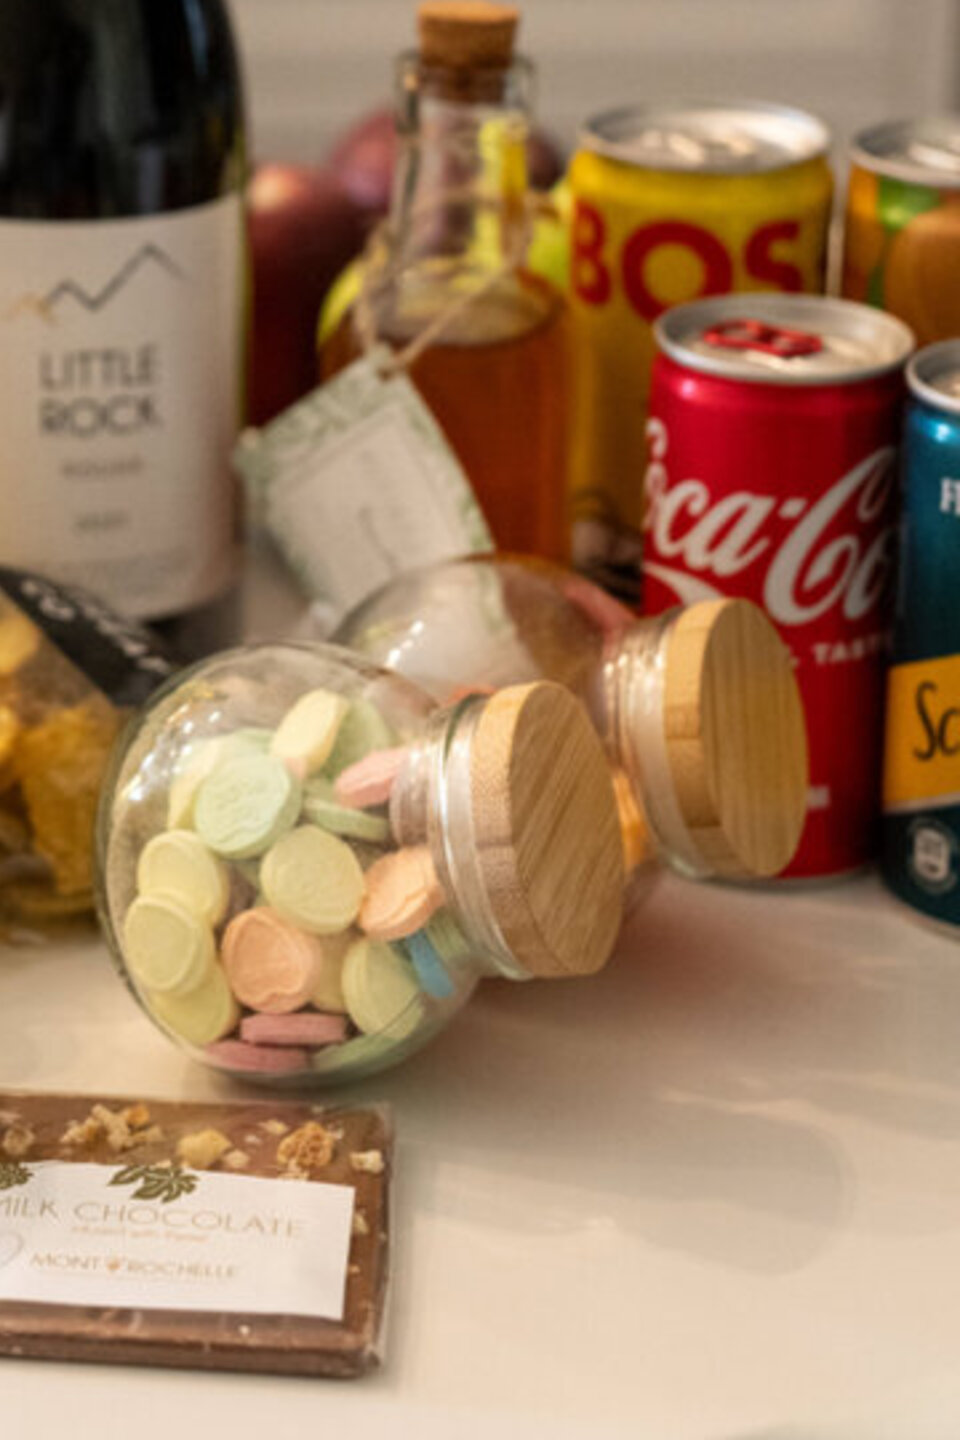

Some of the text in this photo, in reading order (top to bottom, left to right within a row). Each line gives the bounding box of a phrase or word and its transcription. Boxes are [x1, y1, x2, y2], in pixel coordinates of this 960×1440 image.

[572, 198, 803, 326] BOS
[40, 343, 157, 391] LITTLE
[40, 394, 164, 439] ROCK
[73, 1200, 304, 1239] CHOCOLATE
[28, 1251, 237, 1280] MONT ROCHELLE
